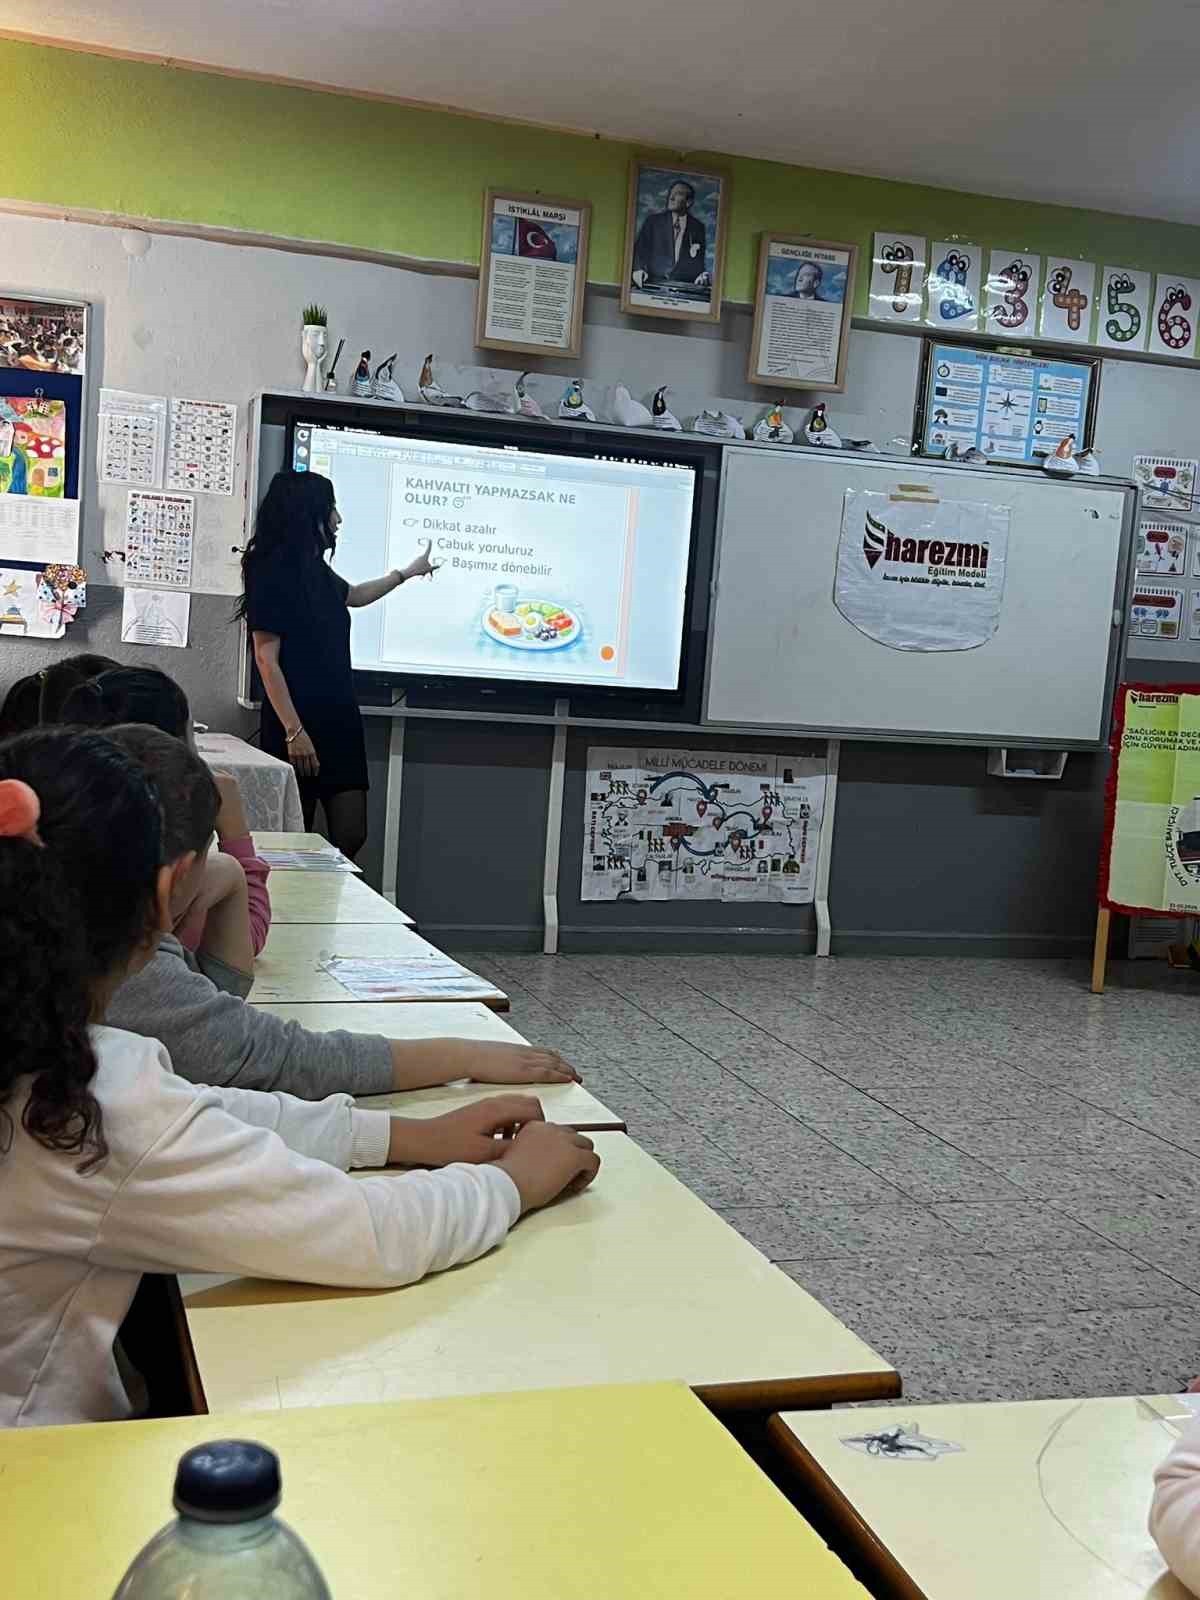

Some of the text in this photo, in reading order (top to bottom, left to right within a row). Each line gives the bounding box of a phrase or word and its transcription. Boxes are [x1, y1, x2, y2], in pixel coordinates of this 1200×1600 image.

[1047, 266, 1088, 331] 4
[1105, 273, 1141, 342] 5
[1158, 283, 1192, 349] 6
[404, 492, 448, 506] OLUR?
[405, 477, 576, 505] KAHVALTI YAPMAZSAK NE
[423, 517, 497, 535] Dikkat azalır
[437, 537, 534, 557] Çabuk yoruluruz
[885, 528, 989, 569] harezmi
[452, 556, 552, 577] Başımız dönebilir
[927, 566, 987, 579] Eğitim Modeli
[1143, 736, 1184, 745] KORUMAK
[671, 757, 726, 770] MÜCADELE
